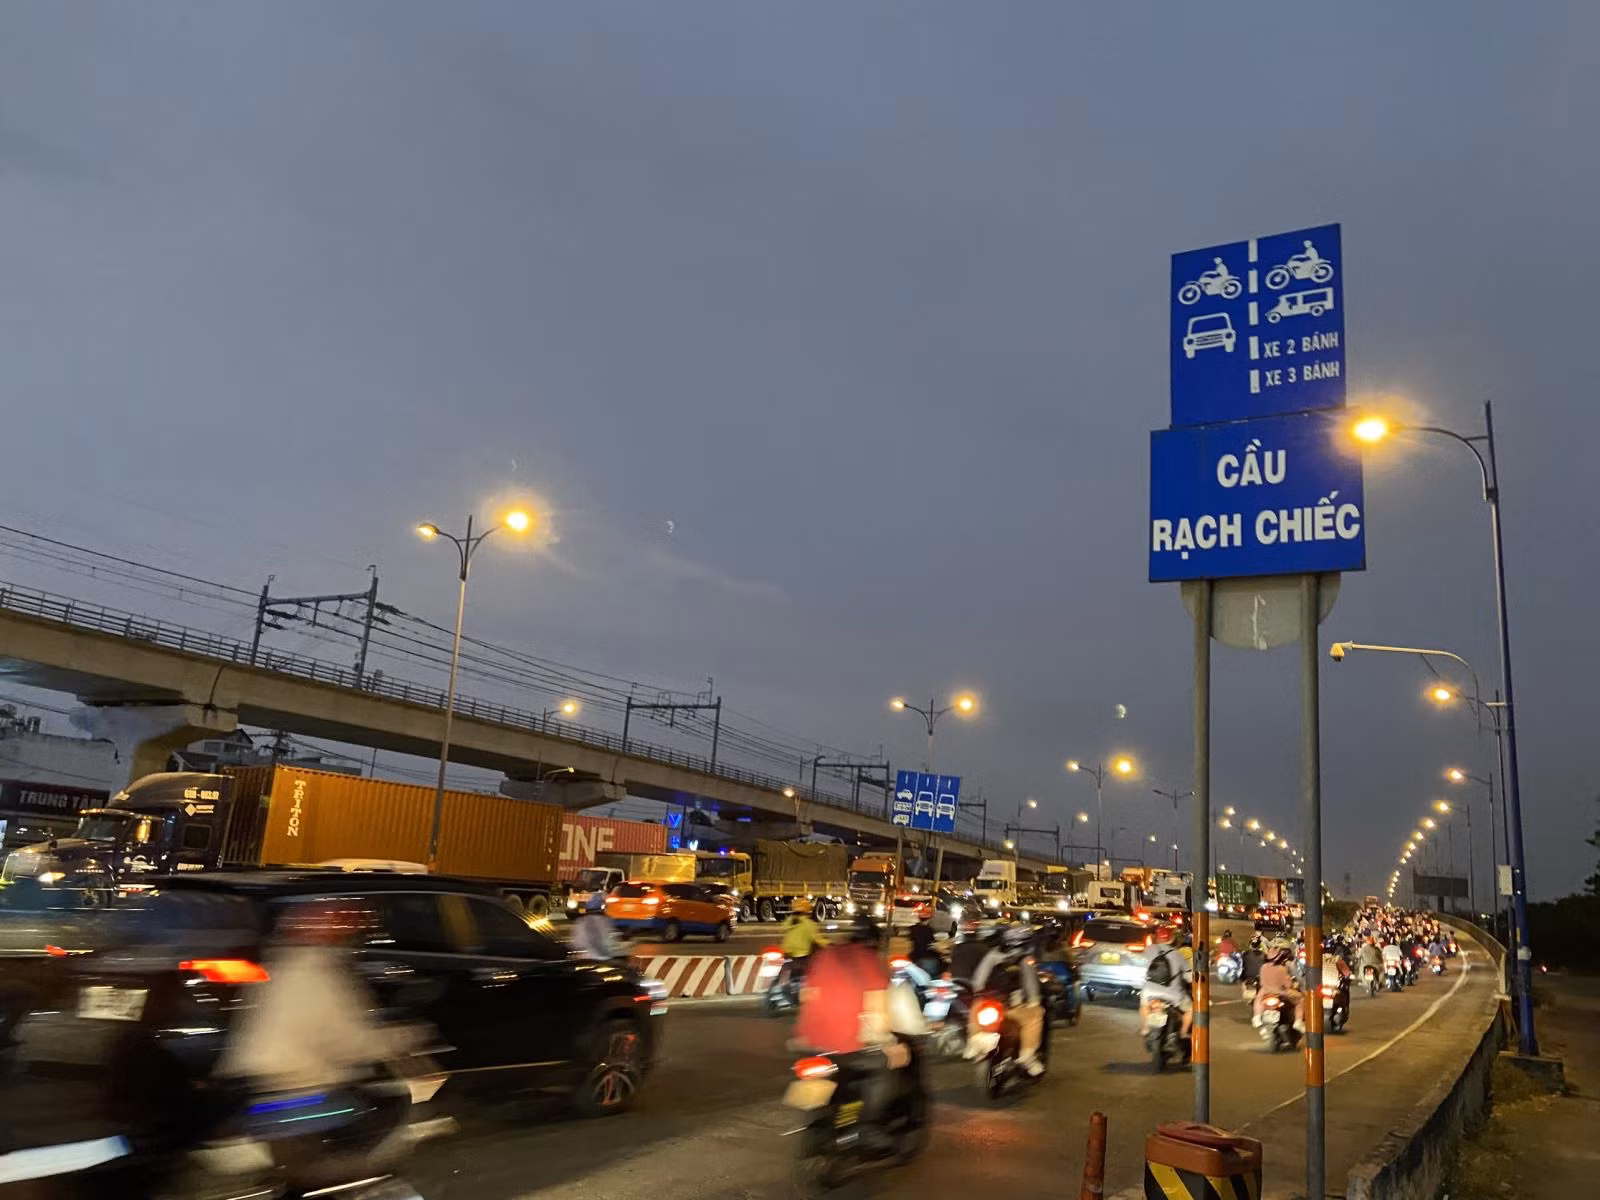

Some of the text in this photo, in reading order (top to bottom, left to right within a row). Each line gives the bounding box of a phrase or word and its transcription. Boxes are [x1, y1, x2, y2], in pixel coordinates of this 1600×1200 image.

[1264, 331, 1339, 358] XE 2 BÁNH
[1265, 360, 1340, 387] XE 3 BÁNH
[1217, 438, 1287, 488] CẦU
[1152, 490, 1361, 560] RẠCH CHIẾC
[20, 790, 68, 808] TRUNG
[286, 780, 307, 837] TRITON
